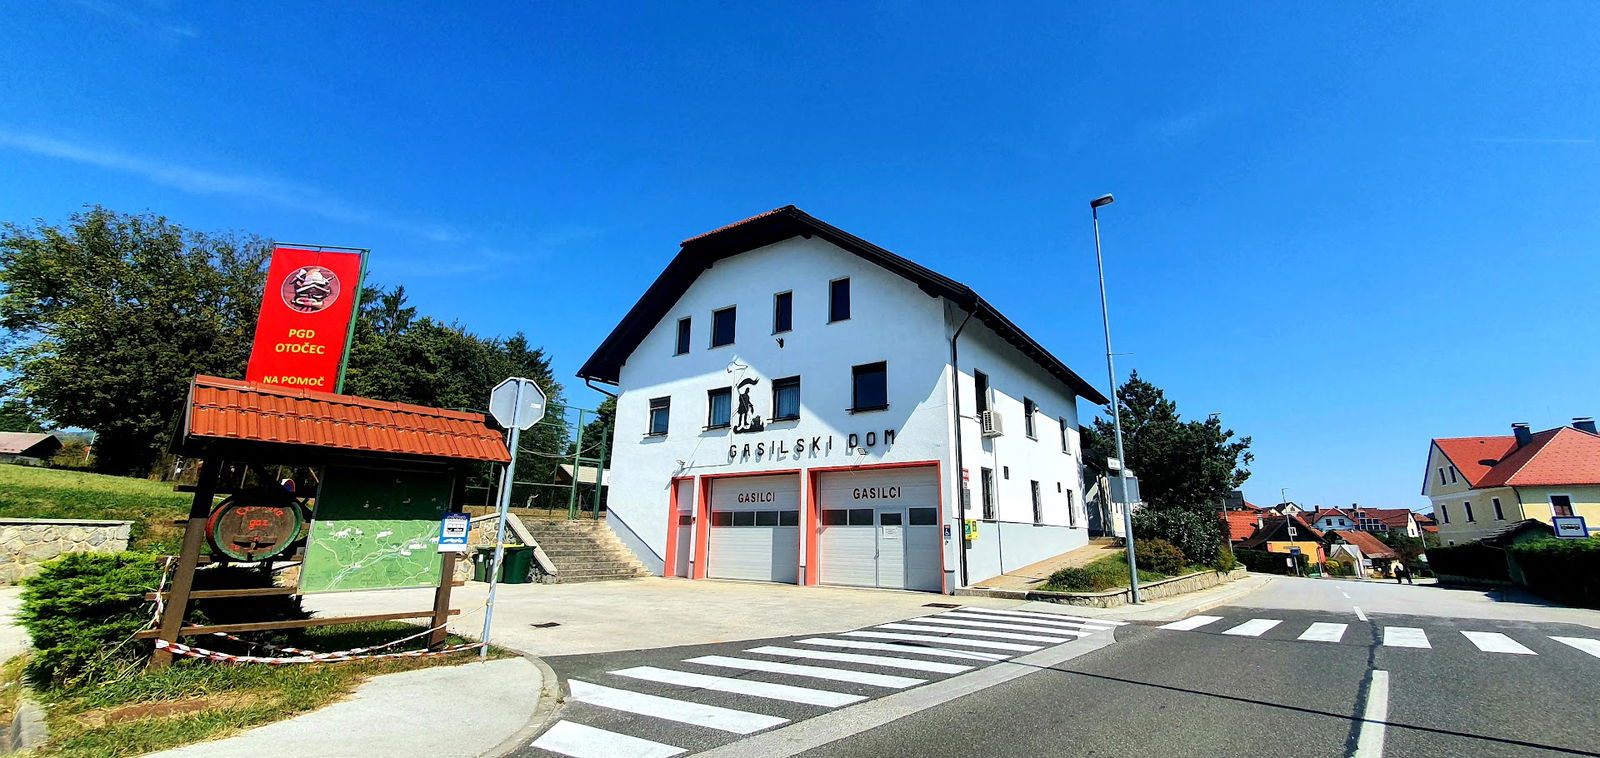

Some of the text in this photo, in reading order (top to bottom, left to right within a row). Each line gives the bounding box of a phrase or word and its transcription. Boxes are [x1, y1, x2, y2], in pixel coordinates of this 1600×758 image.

[288, 328, 315, 338] PGD
[275, 342, 325, 355] OTOČEC
[263, 375, 325, 386] NA POMOČ
[729, 429, 895, 458] GASILSKI DOM
[737, 491, 775, 503] GASILCI
[853, 486, 901, 500] GASILCI
